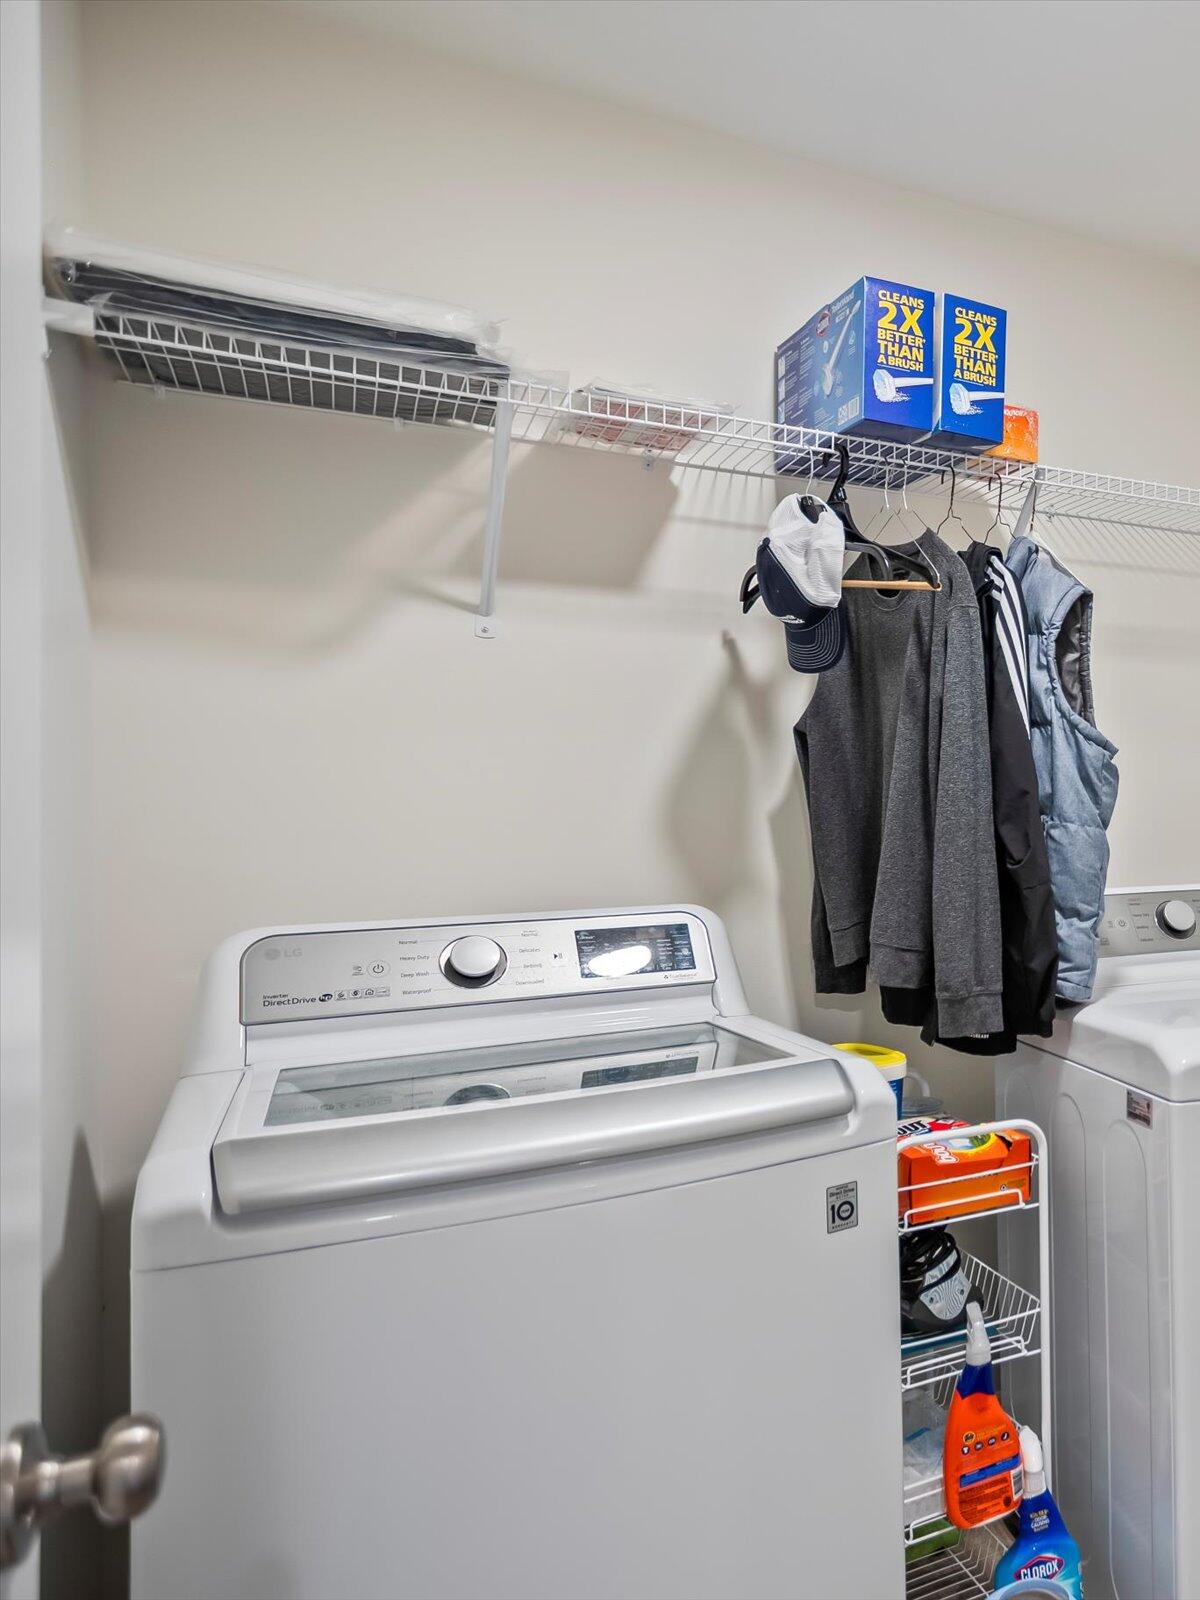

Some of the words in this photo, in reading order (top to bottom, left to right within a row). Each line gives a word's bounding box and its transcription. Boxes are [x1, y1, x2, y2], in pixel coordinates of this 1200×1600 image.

[878, 289, 924, 310] CLEANS
[878, 301, 924, 337] 2X
[955, 307, 997, 326] CLEANS
[954, 318, 996, 353] 2X
[878, 340, 924, 362] THAN
[877, 354, 887, 364] A
[888, 356, 924, 372] BRUSH
[954, 355, 996, 377] THAN
[954, 369, 963, 379] A
[963, 371, 996, 386] BRUSH
[284, 948, 303, 958] LG
[831, 1200, 855, 1224] 10
[1020, 1558, 1059, 1580] CLOROX
